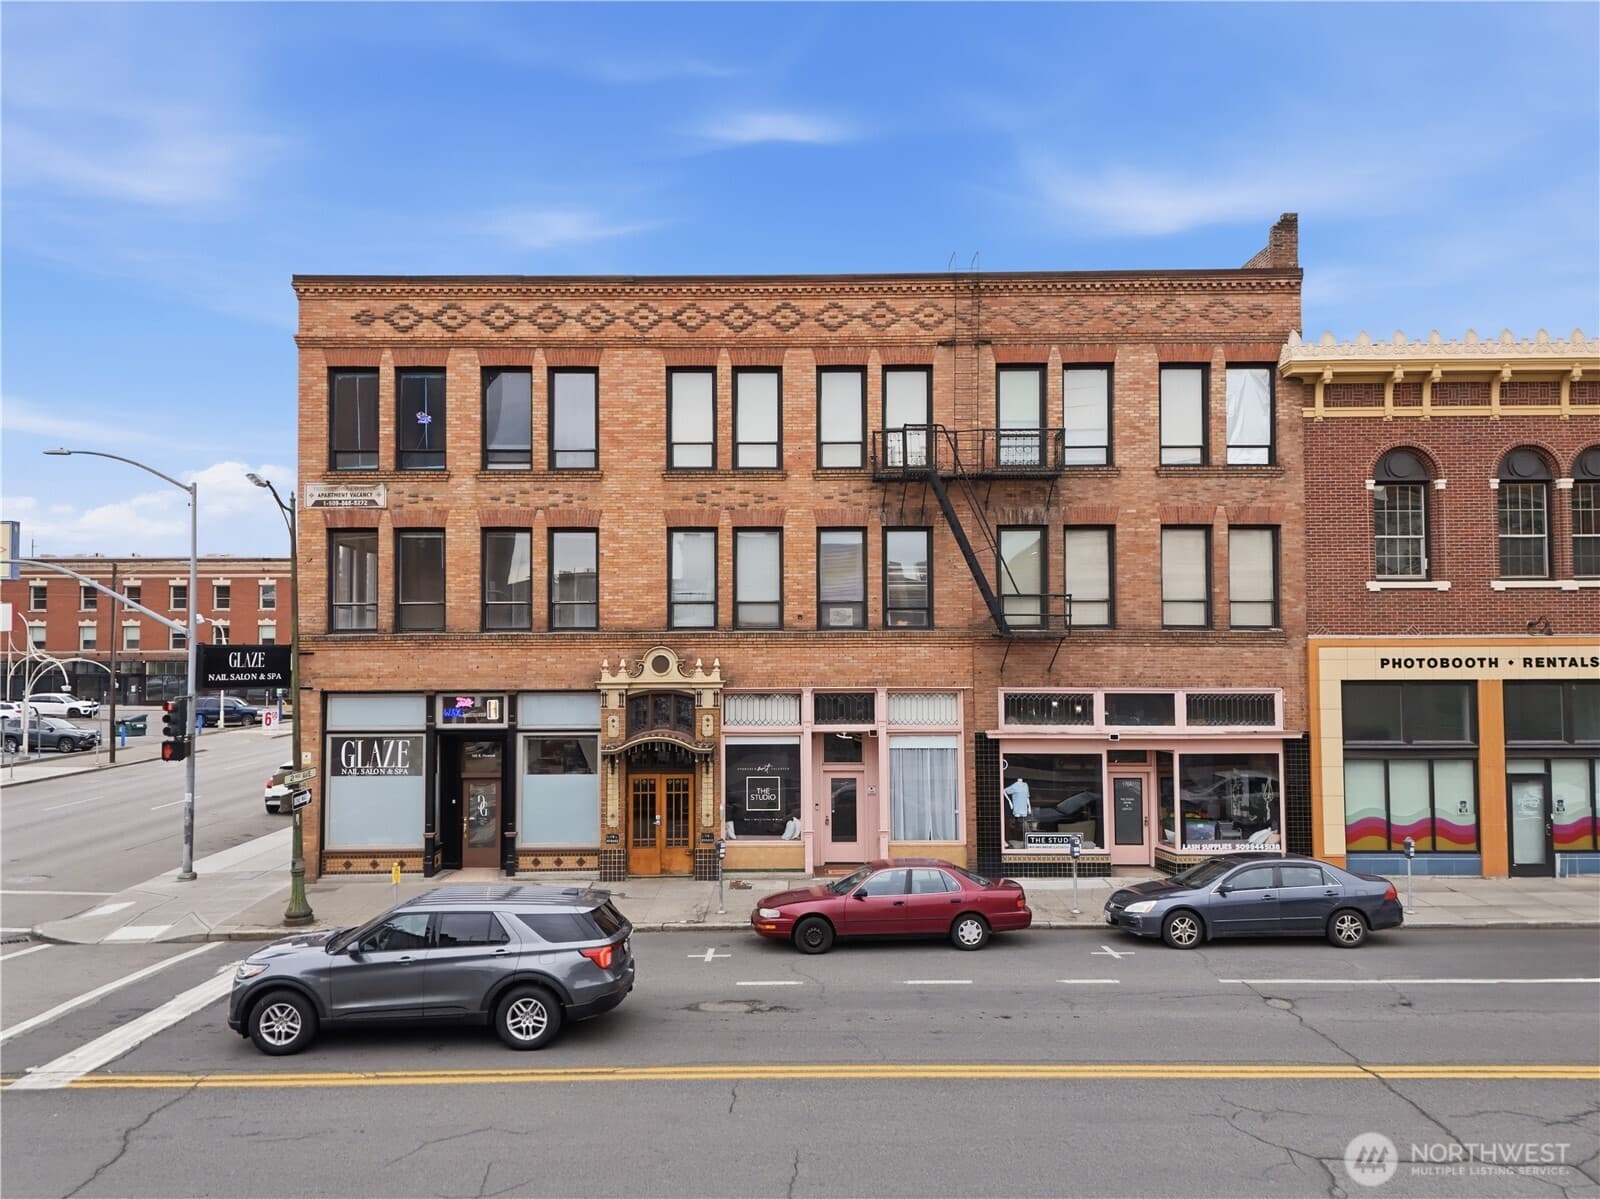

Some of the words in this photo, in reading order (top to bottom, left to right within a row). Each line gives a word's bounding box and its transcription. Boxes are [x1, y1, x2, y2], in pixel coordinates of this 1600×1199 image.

[228, 651, 266, 668] GLAZE
[1380, 657, 1499, 669] PHOTOBOOTH
[1522, 656, 1600, 668] RENTALS
[208, 673, 229, 681] NAIL
[230, 673, 257, 681] SALON
[266, 672, 282, 680] SPA
[341, 739, 410, 768] GLAZE
[750, 793, 777, 801] STUDIO
